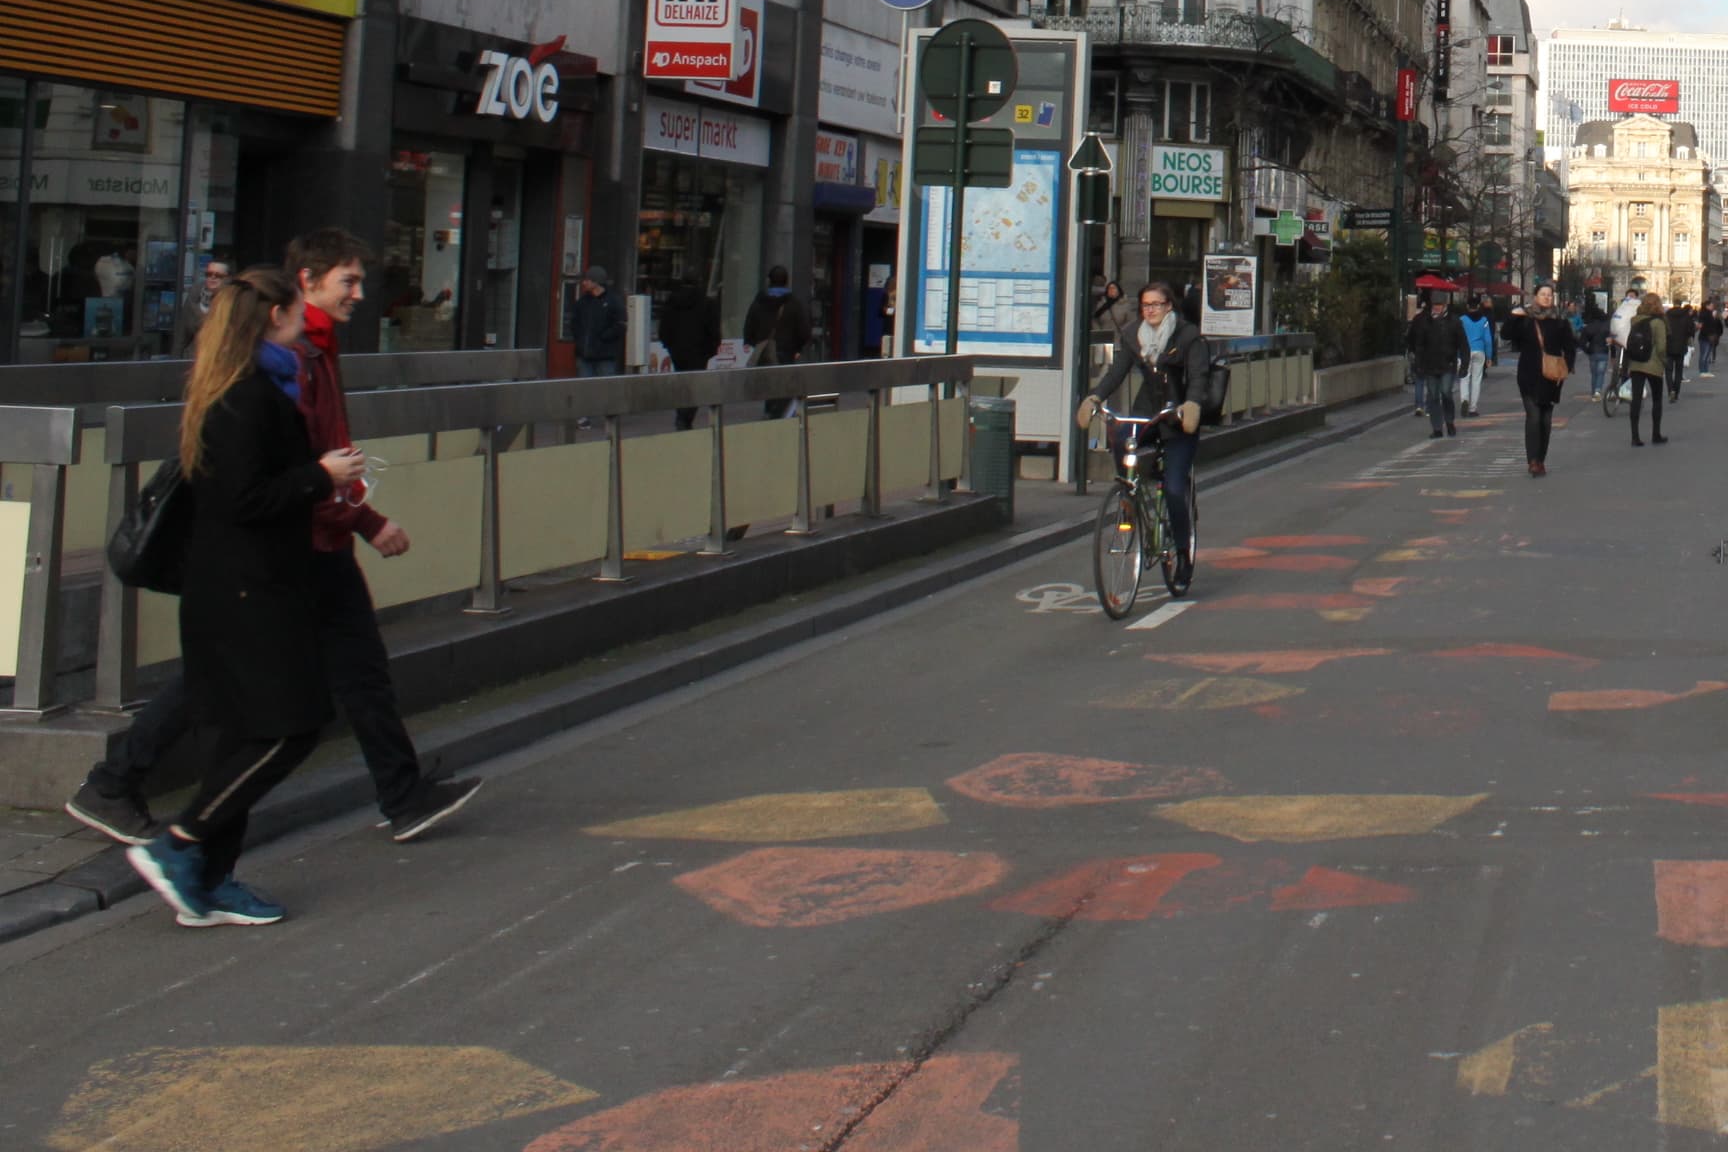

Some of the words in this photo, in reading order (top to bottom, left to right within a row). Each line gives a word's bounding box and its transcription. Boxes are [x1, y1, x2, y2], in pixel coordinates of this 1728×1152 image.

[664, 4, 720, 21] DELHAIZE
[672, 52, 728, 69] Anspach
[1017, 109, 1030, 119] 32
[659, 111, 697, 148] super
[702, 118, 738, 148] markt
[1162, 151, 1213, 173] NEOS
[1151, 172, 1223, 195] BOURSE
